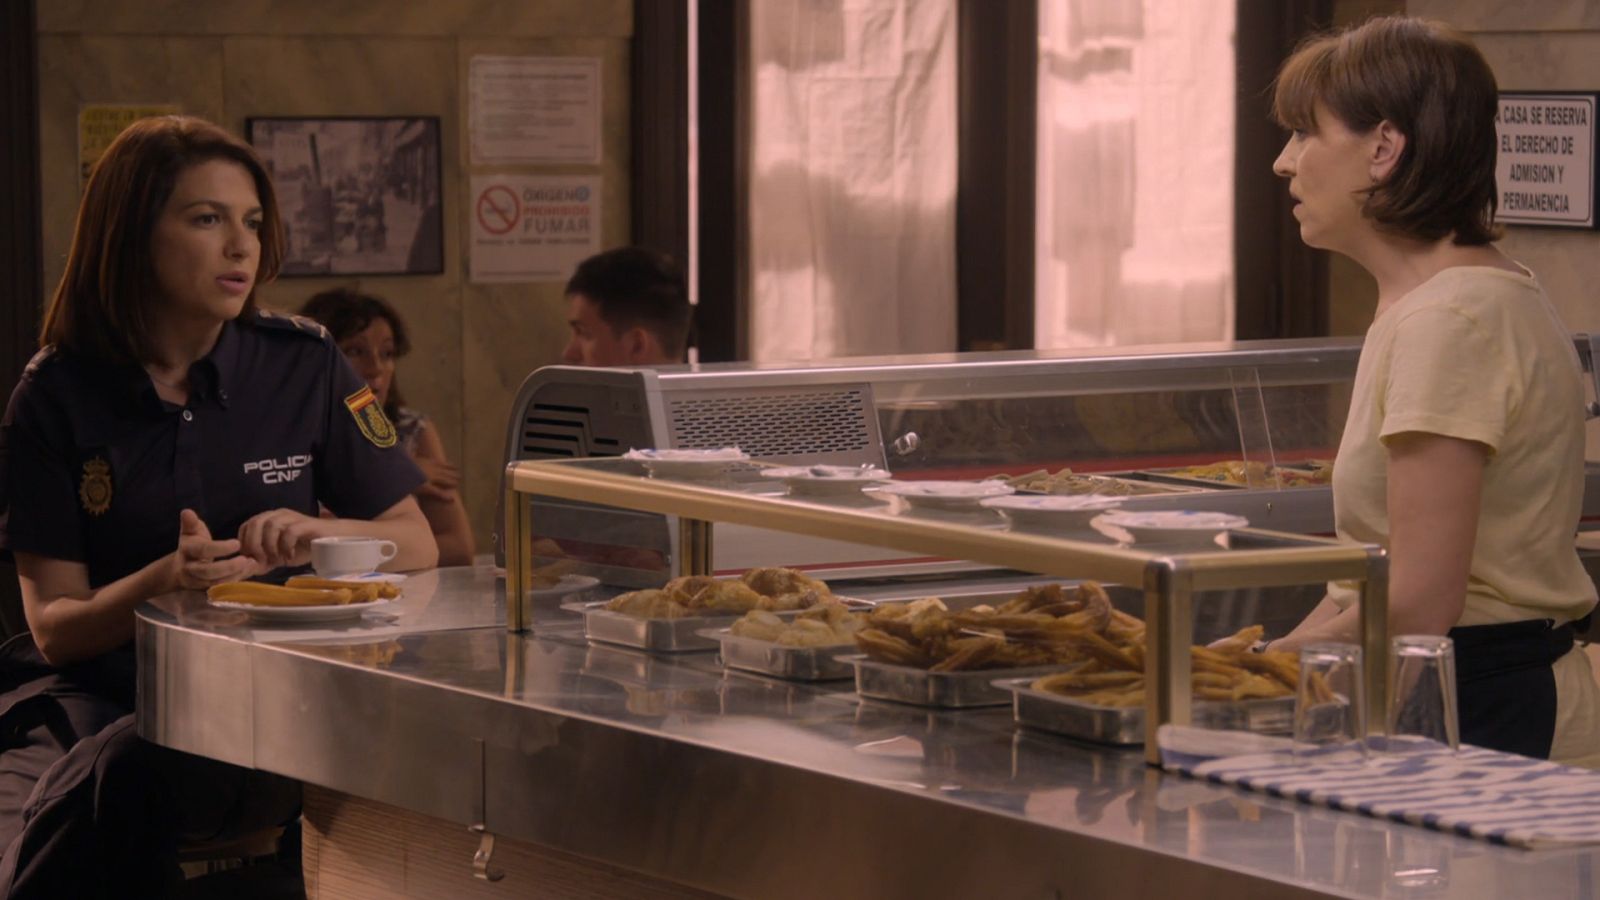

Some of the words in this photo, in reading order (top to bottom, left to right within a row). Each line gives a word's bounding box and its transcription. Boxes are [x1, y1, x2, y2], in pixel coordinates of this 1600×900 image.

[1503, 106, 1528, 124] CASA
[1530, 106, 1542, 124] SE
[1544, 107, 1587, 126] RESERVA
[1501, 135, 1513, 152] EL
[1515, 135, 1559, 154] DERECHO
[1561, 137, 1574, 155] DE
[1510, 164, 1556, 183] ADMISION
[1558, 165, 1565, 184] Y
[523, 205, 591, 217] PROHIBIDO
[1503, 193, 1569, 212] PERMANENCIA
[523, 217, 591, 234] FUMAR
